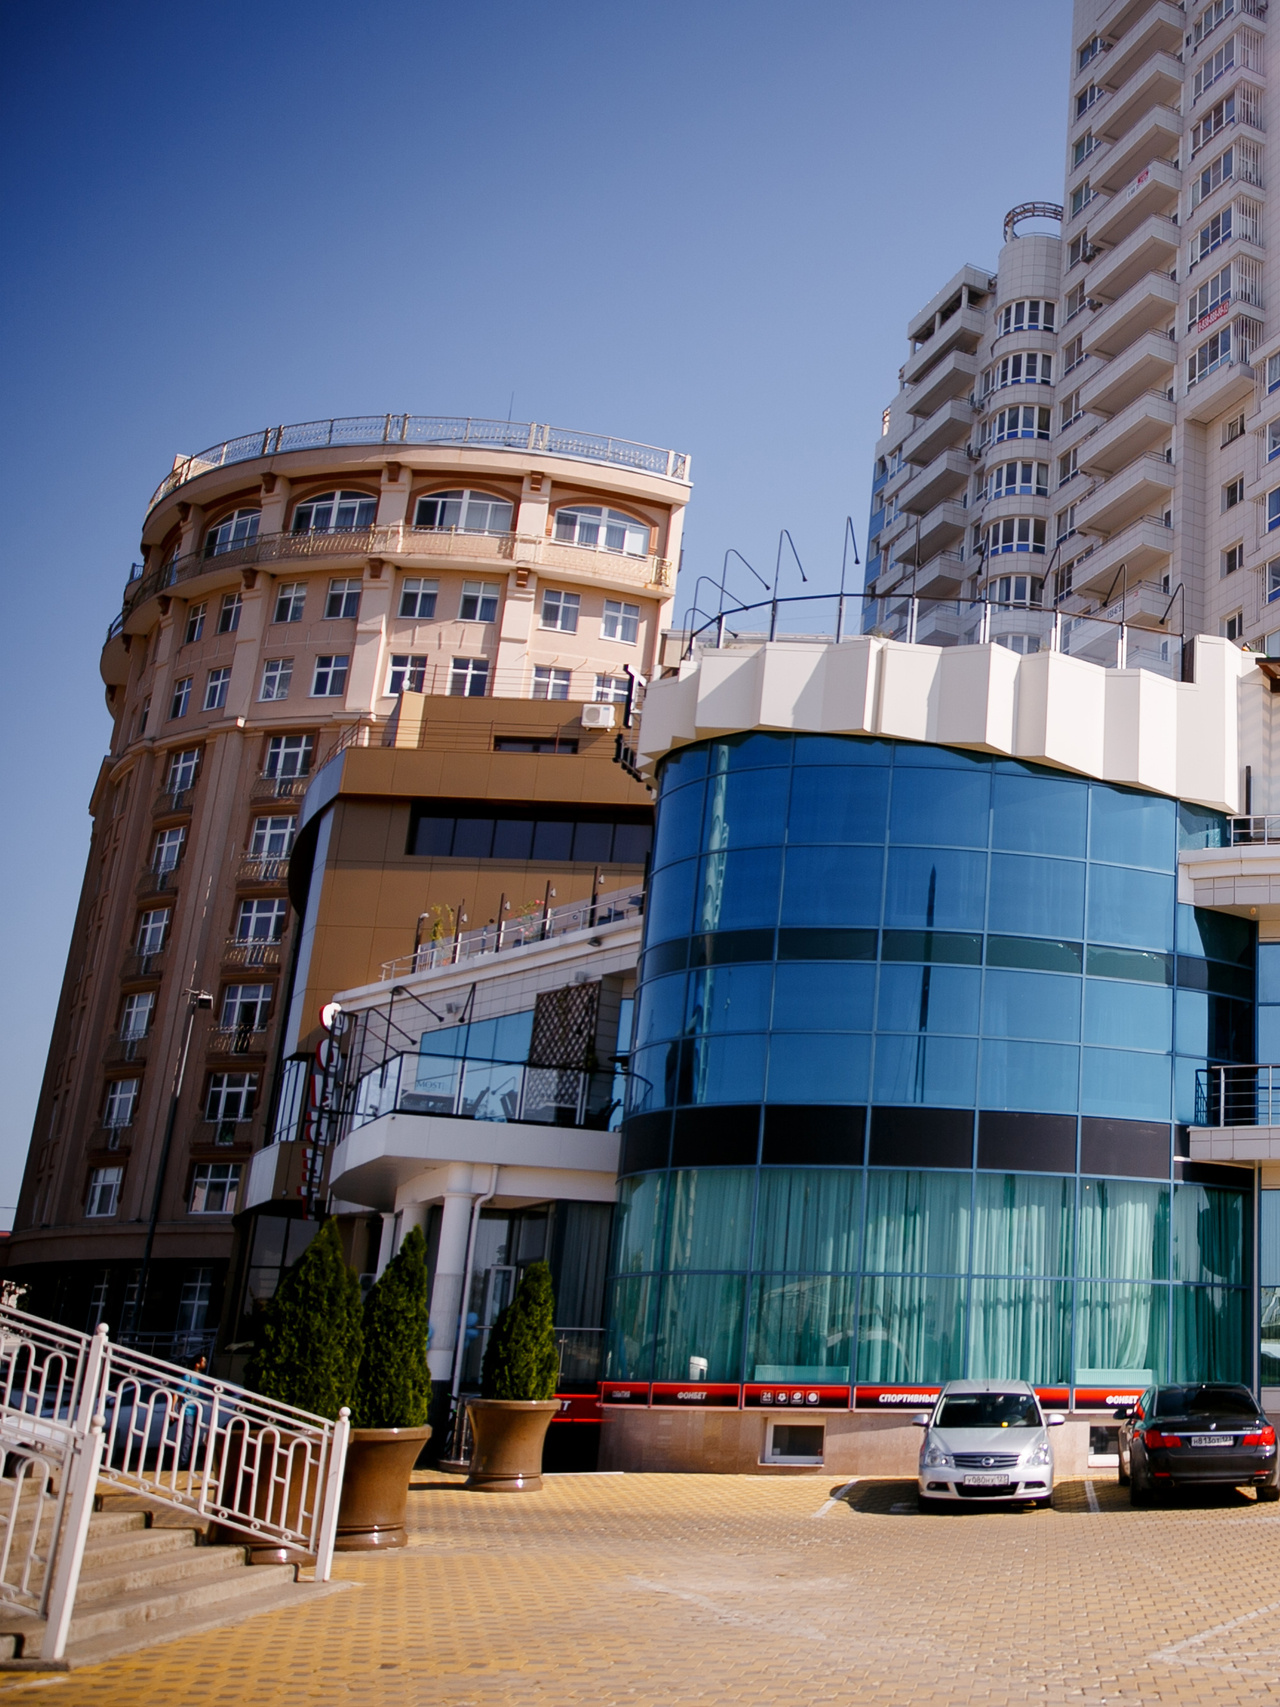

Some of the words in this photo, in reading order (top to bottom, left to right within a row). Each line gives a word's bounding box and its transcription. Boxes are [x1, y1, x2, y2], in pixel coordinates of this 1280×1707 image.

[677, 1391, 707, 1400] ФОНБЕТ
[762, 1391, 771, 1399] 24
[1105, 1395, 1139, 1405] ФОНБЕТ
